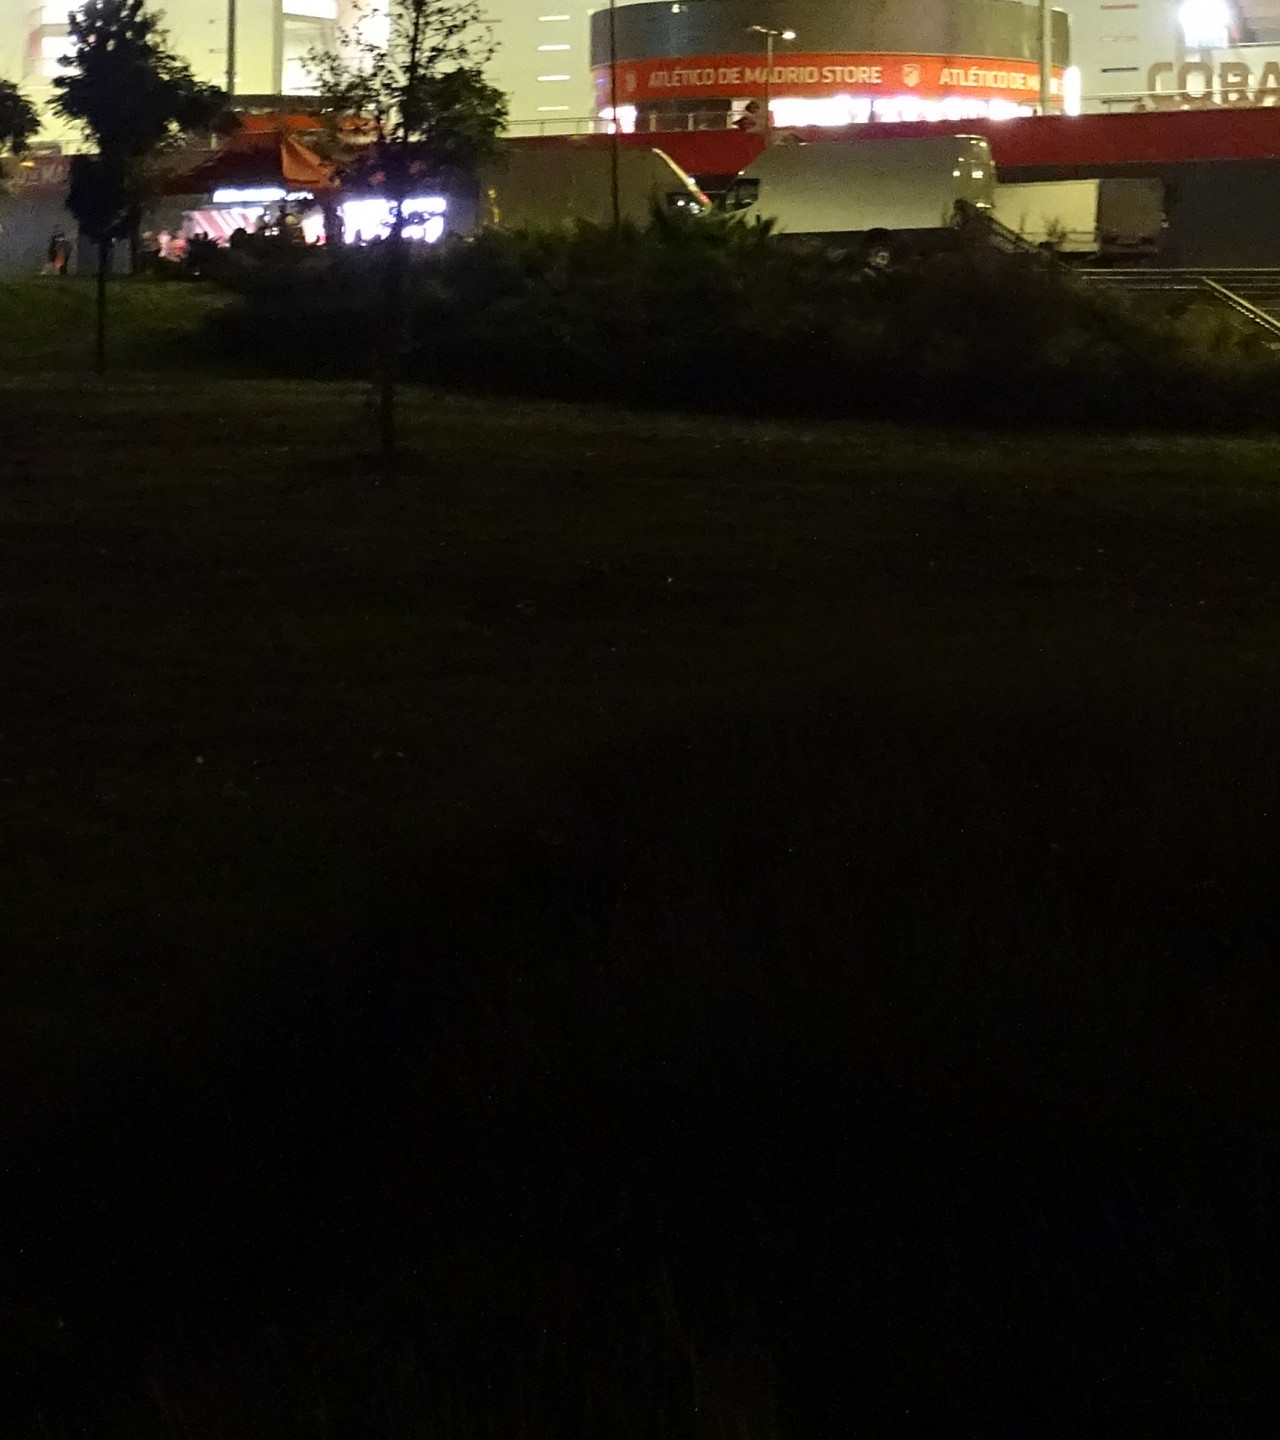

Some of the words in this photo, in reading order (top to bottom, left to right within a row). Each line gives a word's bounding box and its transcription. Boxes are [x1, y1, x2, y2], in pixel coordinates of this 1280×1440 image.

[648, 66, 714, 88] ATLÉTICO
[720, 67, 741, 86] DE
[744, 66, 819, 85] MADRID
[822, 66, 882, 84] STORE
[939, 66, 1008, 88] ATLÉTICO
